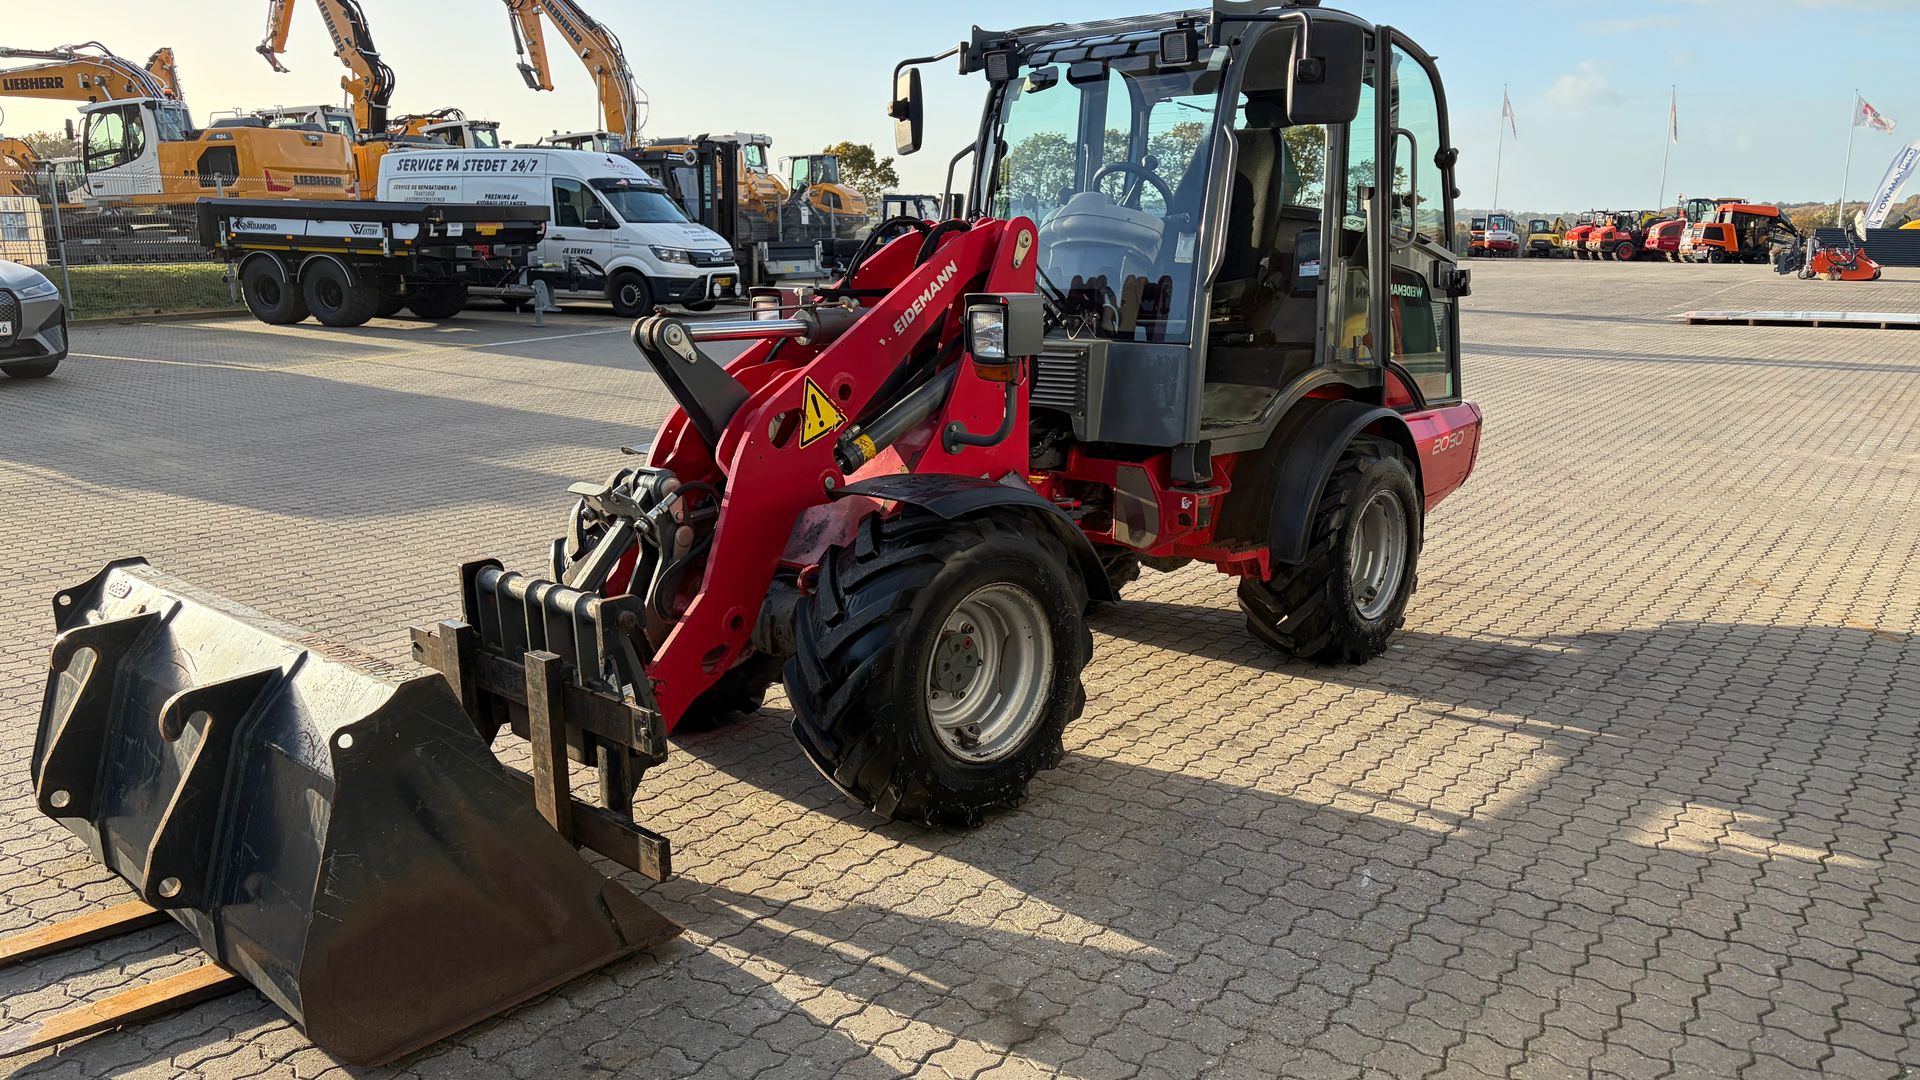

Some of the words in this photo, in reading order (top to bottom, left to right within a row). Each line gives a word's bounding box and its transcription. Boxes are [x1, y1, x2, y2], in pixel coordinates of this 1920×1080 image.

[316, 0, 345, 53] IEBHERR
[3, 76, 64, 91] LIEBHERR
[397, 158, 443, 172] SERVICE
[446, 156, 460, 172] PÅ
[463, 159, 507, 172] STEDET
[511, 157, 538, 174] 24/7
[293, 174, 343, 186] LIEBHERR
[1876, 169, 1905, 214] TOW-MAX
[1899, 148, 1916, 170] PRO
[570, 247, 593, 255] SERVICE
